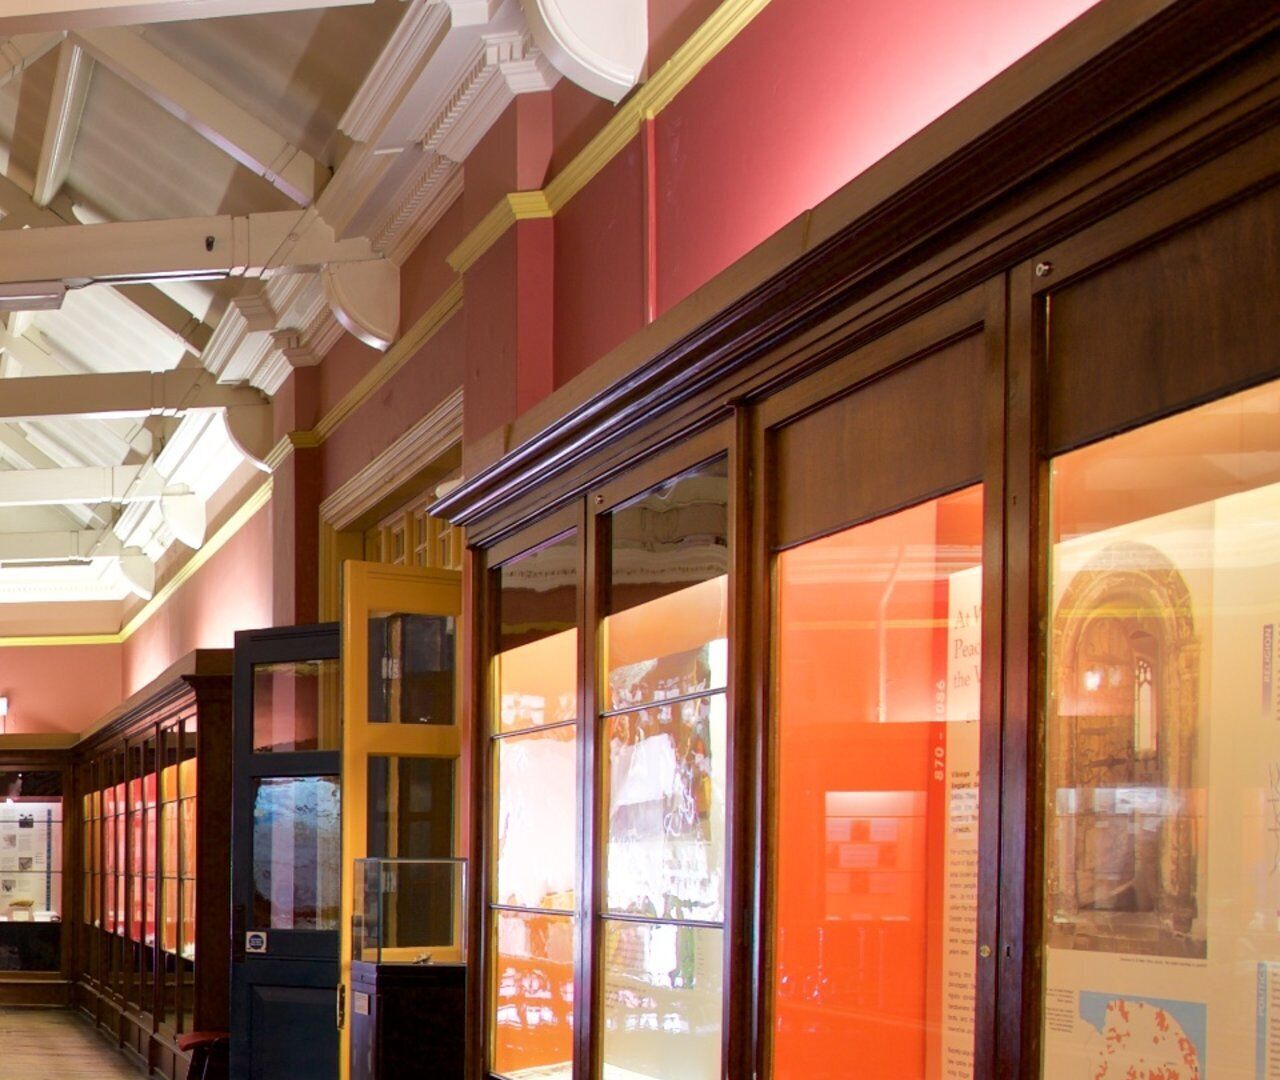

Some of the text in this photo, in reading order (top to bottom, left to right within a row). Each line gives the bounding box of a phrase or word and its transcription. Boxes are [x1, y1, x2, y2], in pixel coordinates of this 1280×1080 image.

[1263, 628, 1272, 682] RELIGION
[954, 671, 972, 689] the
[935, 679, 946, 720] 086
[933, 746, 945, 781] 870
